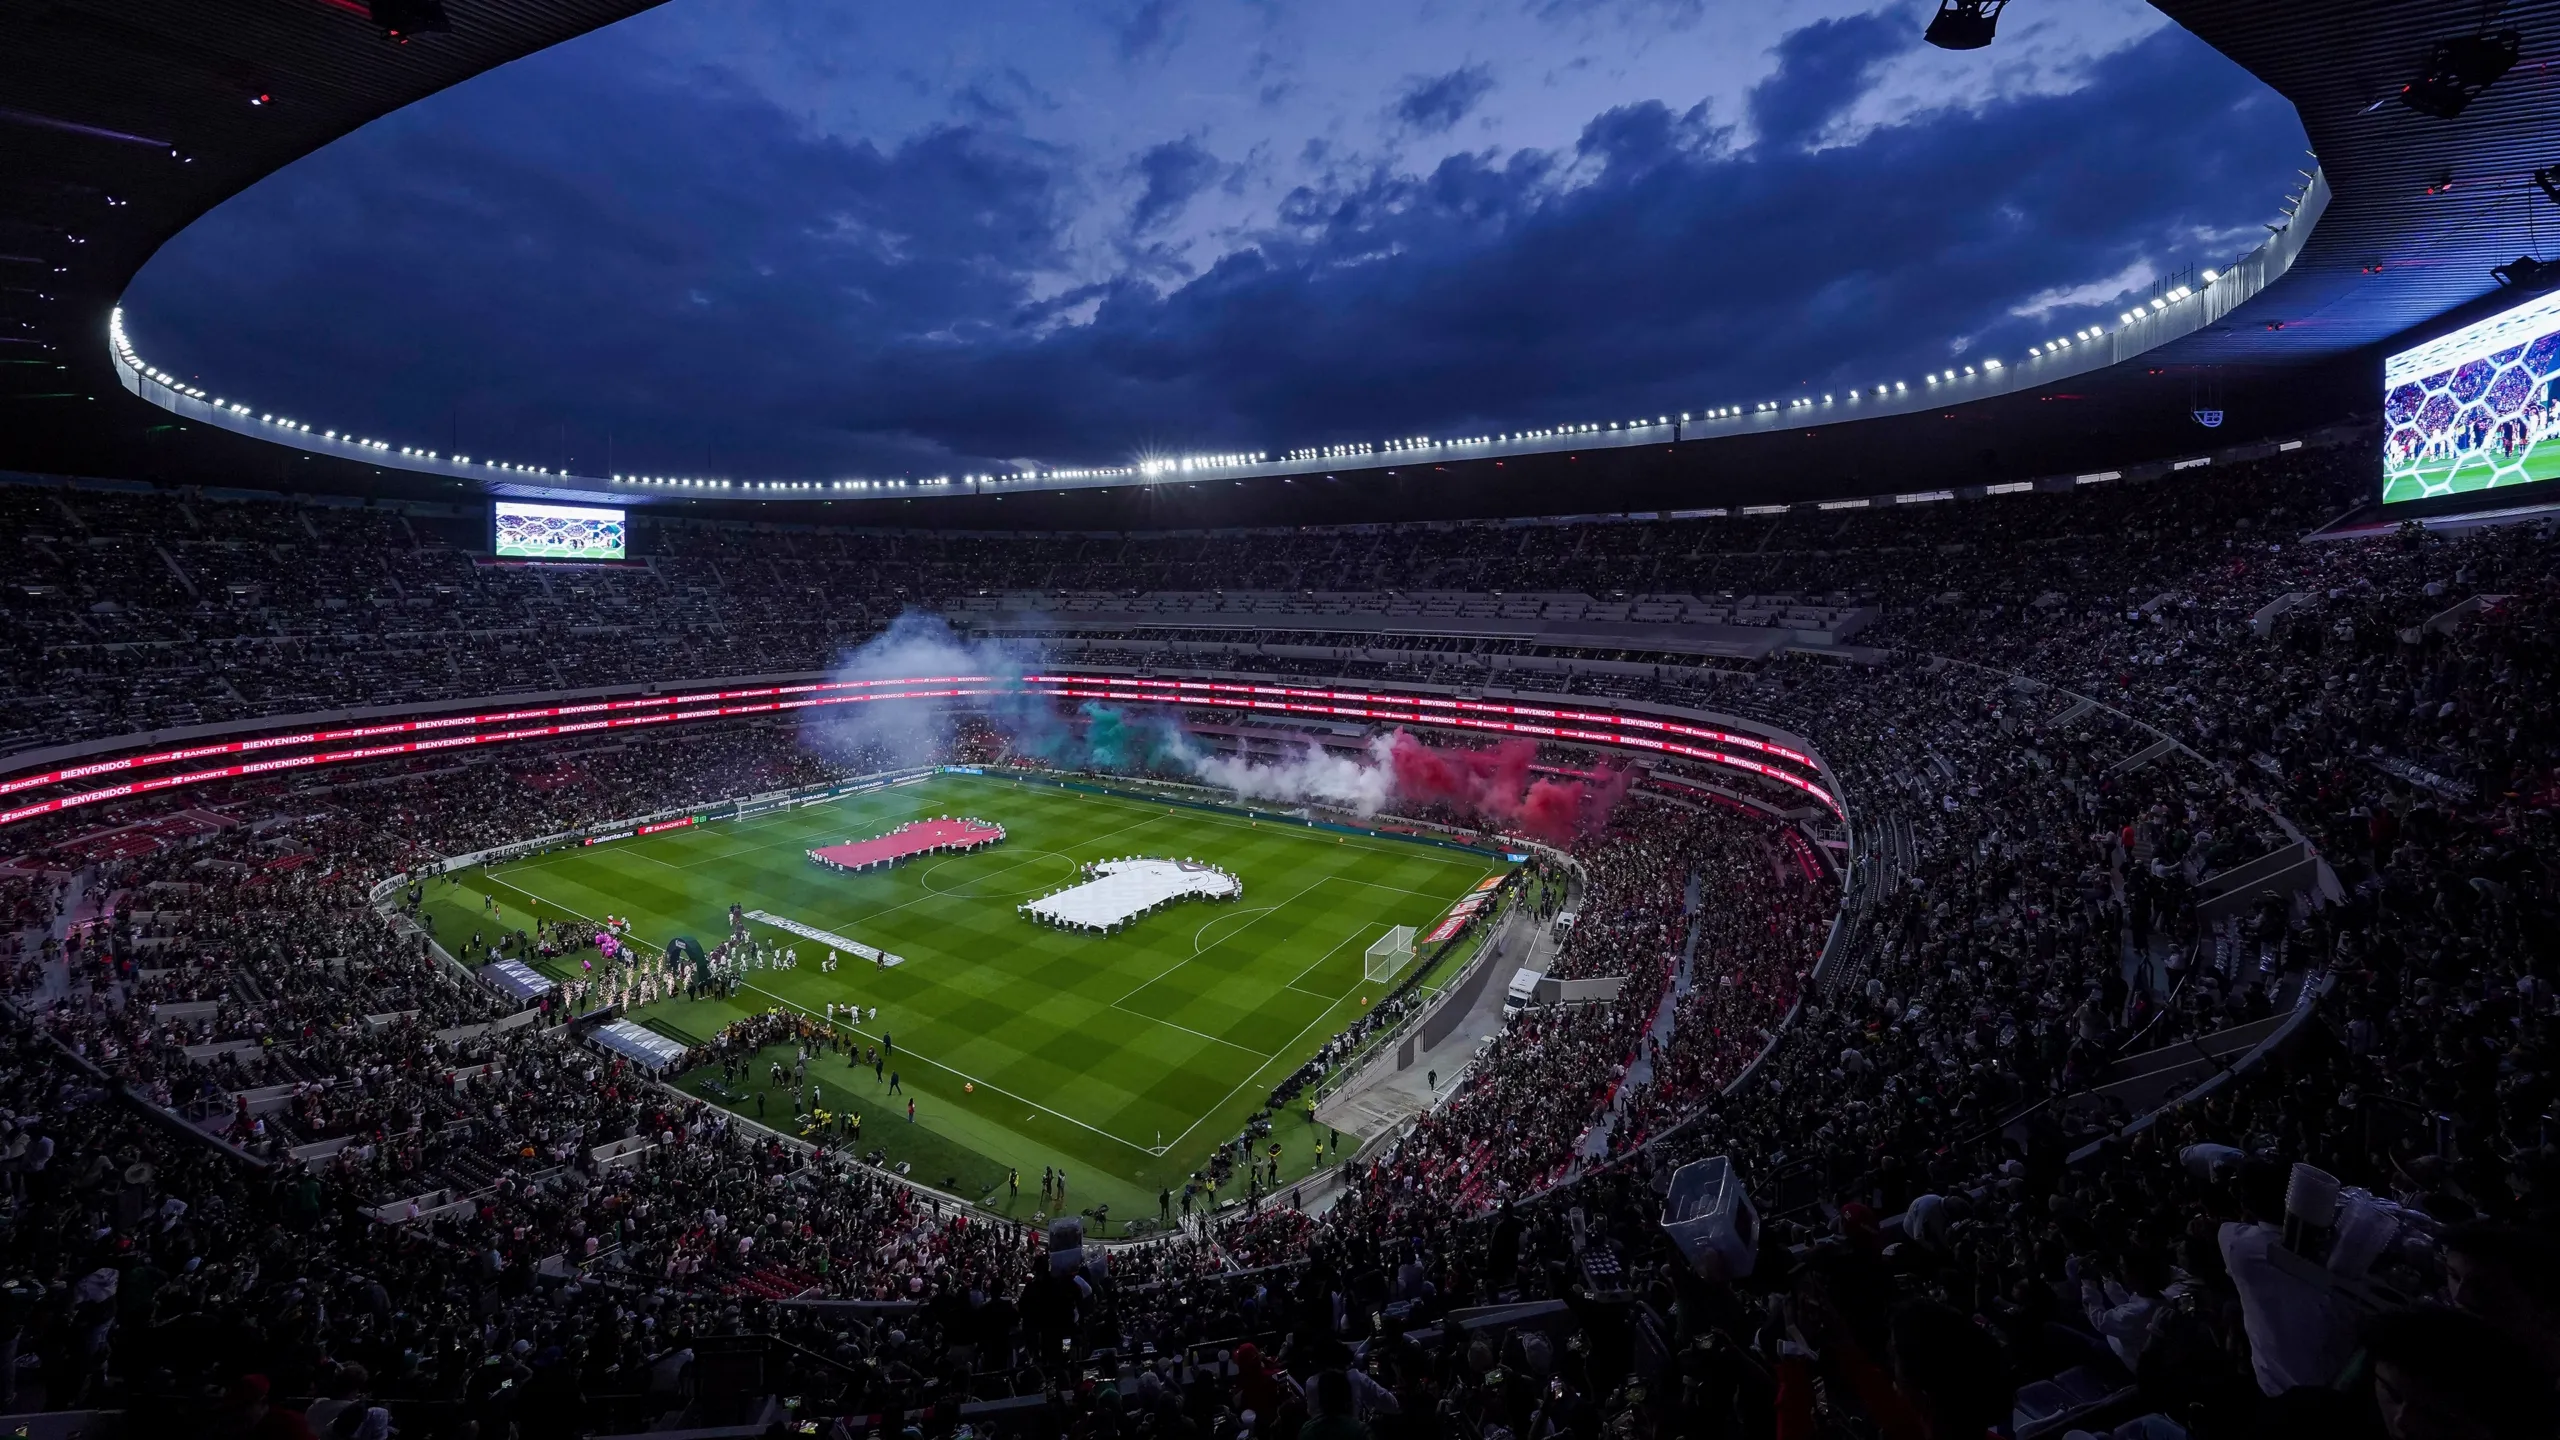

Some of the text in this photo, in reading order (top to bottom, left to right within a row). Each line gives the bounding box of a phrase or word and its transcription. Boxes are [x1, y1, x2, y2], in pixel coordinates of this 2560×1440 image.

[11, 777, 50, 789] BANORTE
[61, 760, 132, 779] BIENVENIDOS
[184, 747, 229, 757] BANORTE
[243, 735, 315, 749] BIENVENIDOS
[365, 726, 405, 734] BANORTE
[416, 717, 476, 729] BIENVENIDOS
[559, 704, 609, 714] BIENVENIDOS
[677, 694, 720, 702] BIENVENIDOS
[1515, 708, 1554, 716] BIENVENIDOS
[1621, 718, 1663, 729] BIENVENIDOS
[1692, 730, 1718, 738] BANORTE
[1725, 735, 1763, 749] BIENVENIDOS
[11, 805, 50, 819] BANORTE
[61, 786, 132, 807] BIENVENIDOS
[143, 780, 170, 788] ESTADIO
[184, 770, 229, 781] BANORTE
[243, 757, 315, 772] BIENVENIDOS
[365, 747, 405, 755] BANORTE
[416, 737, 476, 749] BIENVENIDOS
[516, 729, 549, 737] BANORTE
[559, 722, 609, 732] BIENVENIDOS
[677, 710, 720, 718] BIENVENIDOS
[780, 700, 818, 708] BIENVENIDOS
[1515, 725, 1554, 734] BIENVENIDOS
[1621, 737, 1663, 748] BIENVENIDOS
[1692, 750, 1718, 759] BANORTE
[1724, 756, 1762, 771] BIENVENIDOS
[654, 820, 688, 831] BANORTE
[593, 831, 634, 844] caliente.mx
[771, 919, 817, 937] SOMOS
